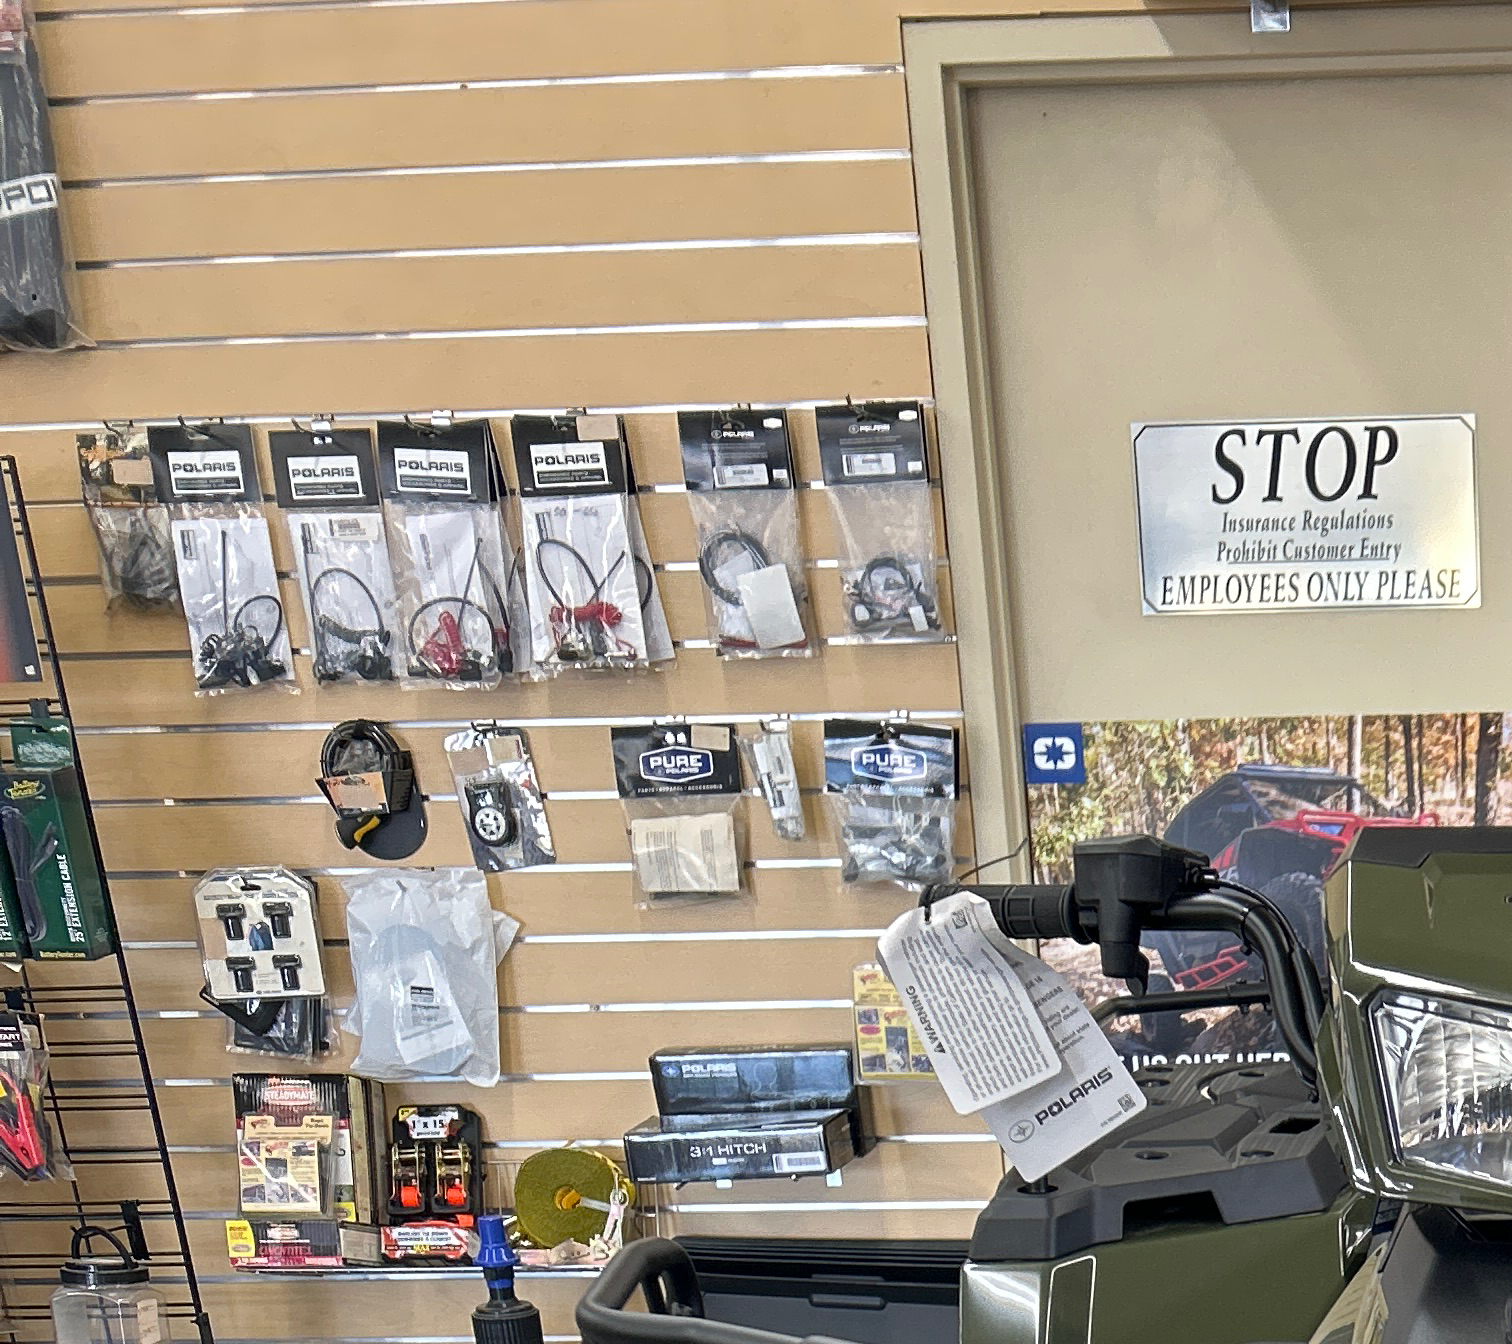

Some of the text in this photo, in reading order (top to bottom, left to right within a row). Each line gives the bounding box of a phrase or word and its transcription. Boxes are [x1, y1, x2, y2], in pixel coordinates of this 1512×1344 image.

[171, 461, 237, 473] POLARIS
[397, 459, 464, 473] POLARIS
[534, 453, 601, 466] POLARIS
[1211, 425, 1399, 505] STOP
[291, 466, 355, 479] POLARIS
[1221, 508, 1394, 537] Insurance Regulations
[1217, 537, 1402, 564] Prohibit Customer Entry
[1160, 568, 1462, 606] EMPLOYEES ONLY PLEASE
[649, 754, 703, 769] PURE
[862, 753, 916, 768] PURE
[905, 985, 940, 1045] WARNING
[681, 1063, 737, 1074] POLARIS
[1034, 1066, 1113, 1127] POLARIS
[718, 1142, 767, 1156] HITCH
